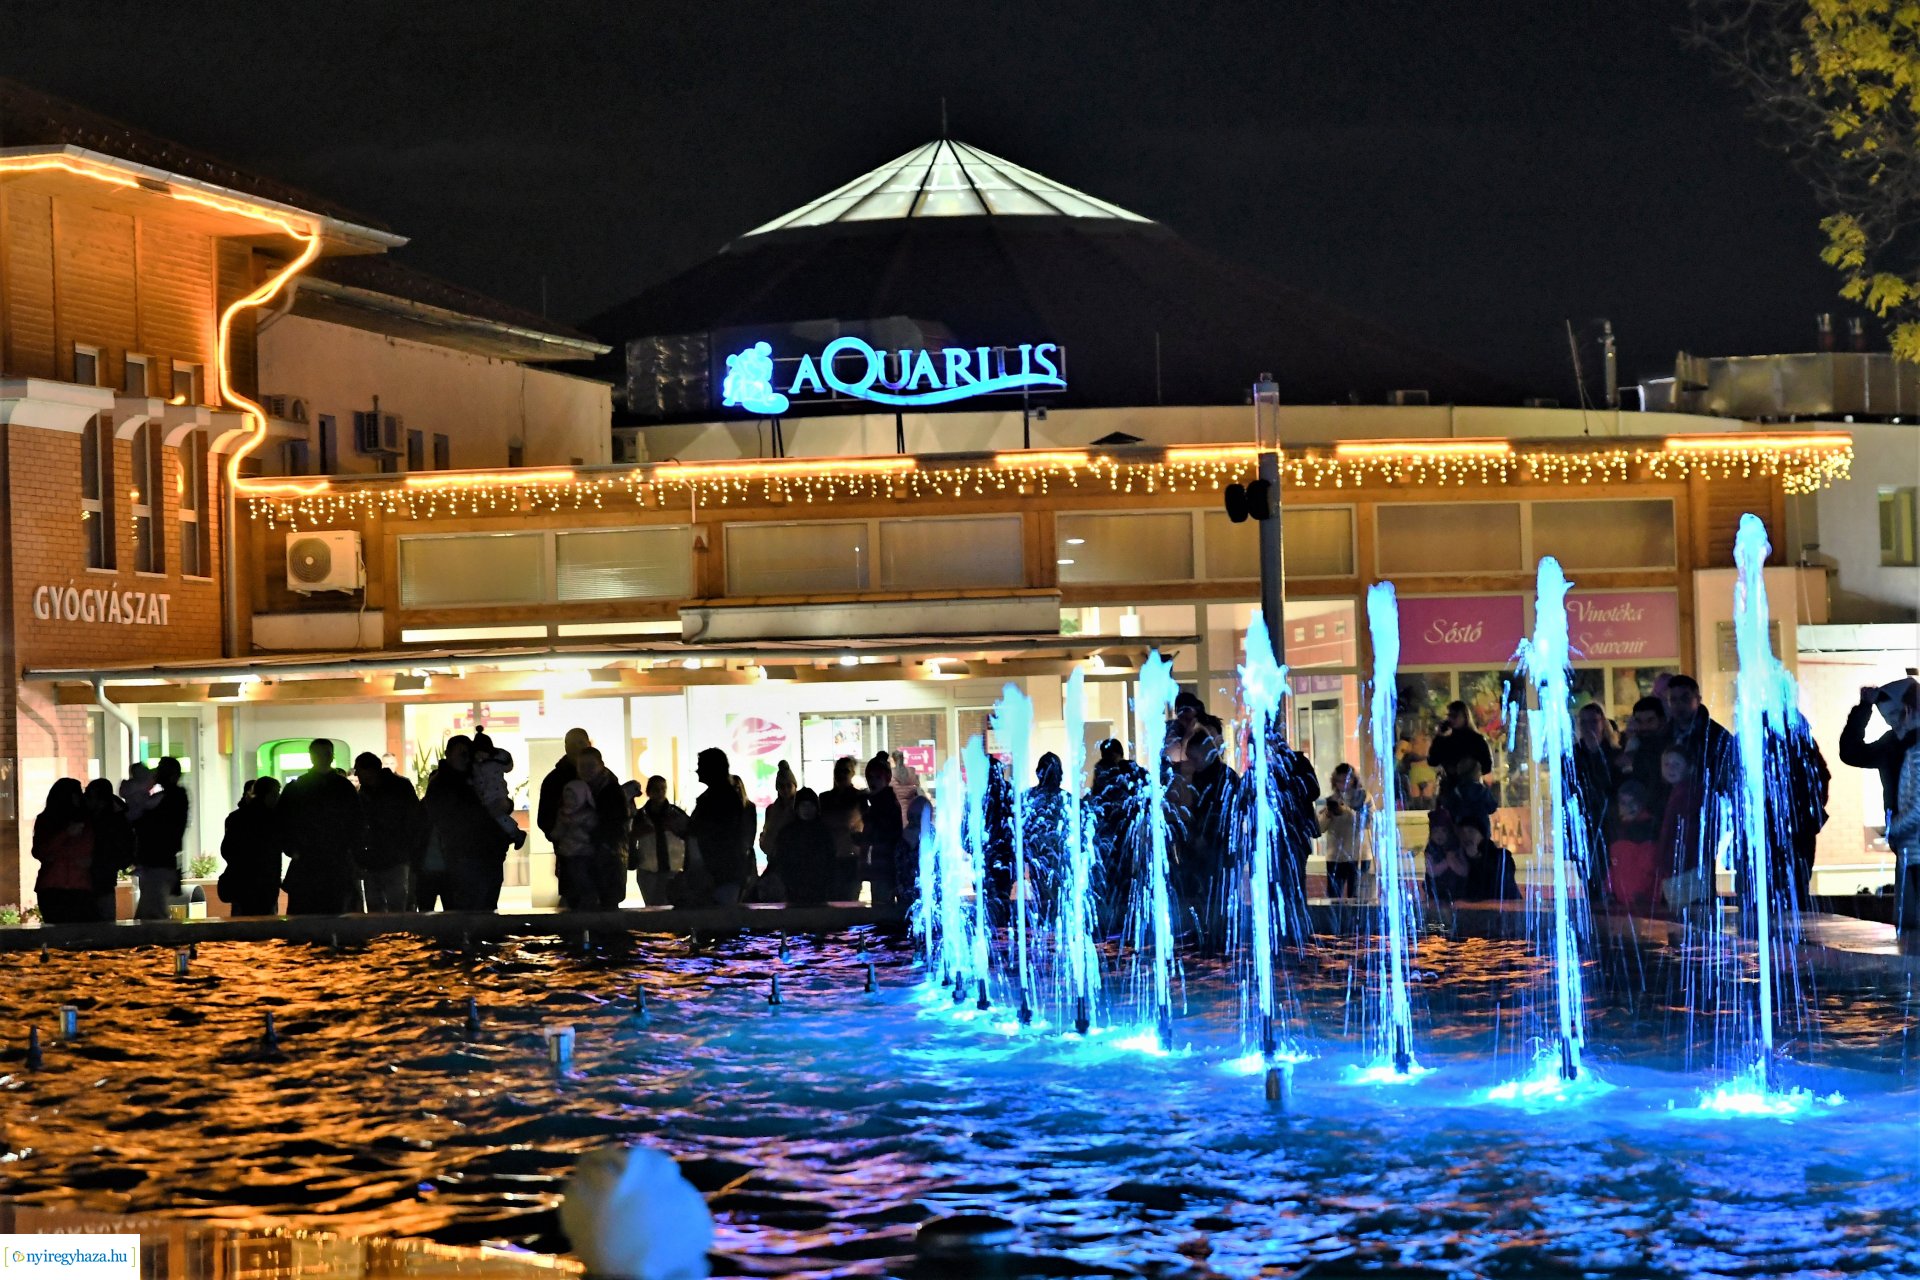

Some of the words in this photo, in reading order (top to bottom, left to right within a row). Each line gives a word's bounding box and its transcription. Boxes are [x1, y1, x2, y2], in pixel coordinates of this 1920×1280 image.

[788, 336, 1067, 405] AQUARIUS
[33, 578, 171, 625] GYÓGYÁSZAT
[1566, 600, 1644, 622] Vinotéka
[1424, 618, 1483, 644] Sóstó
[1579, 632, 1647, 655] Souvenir
